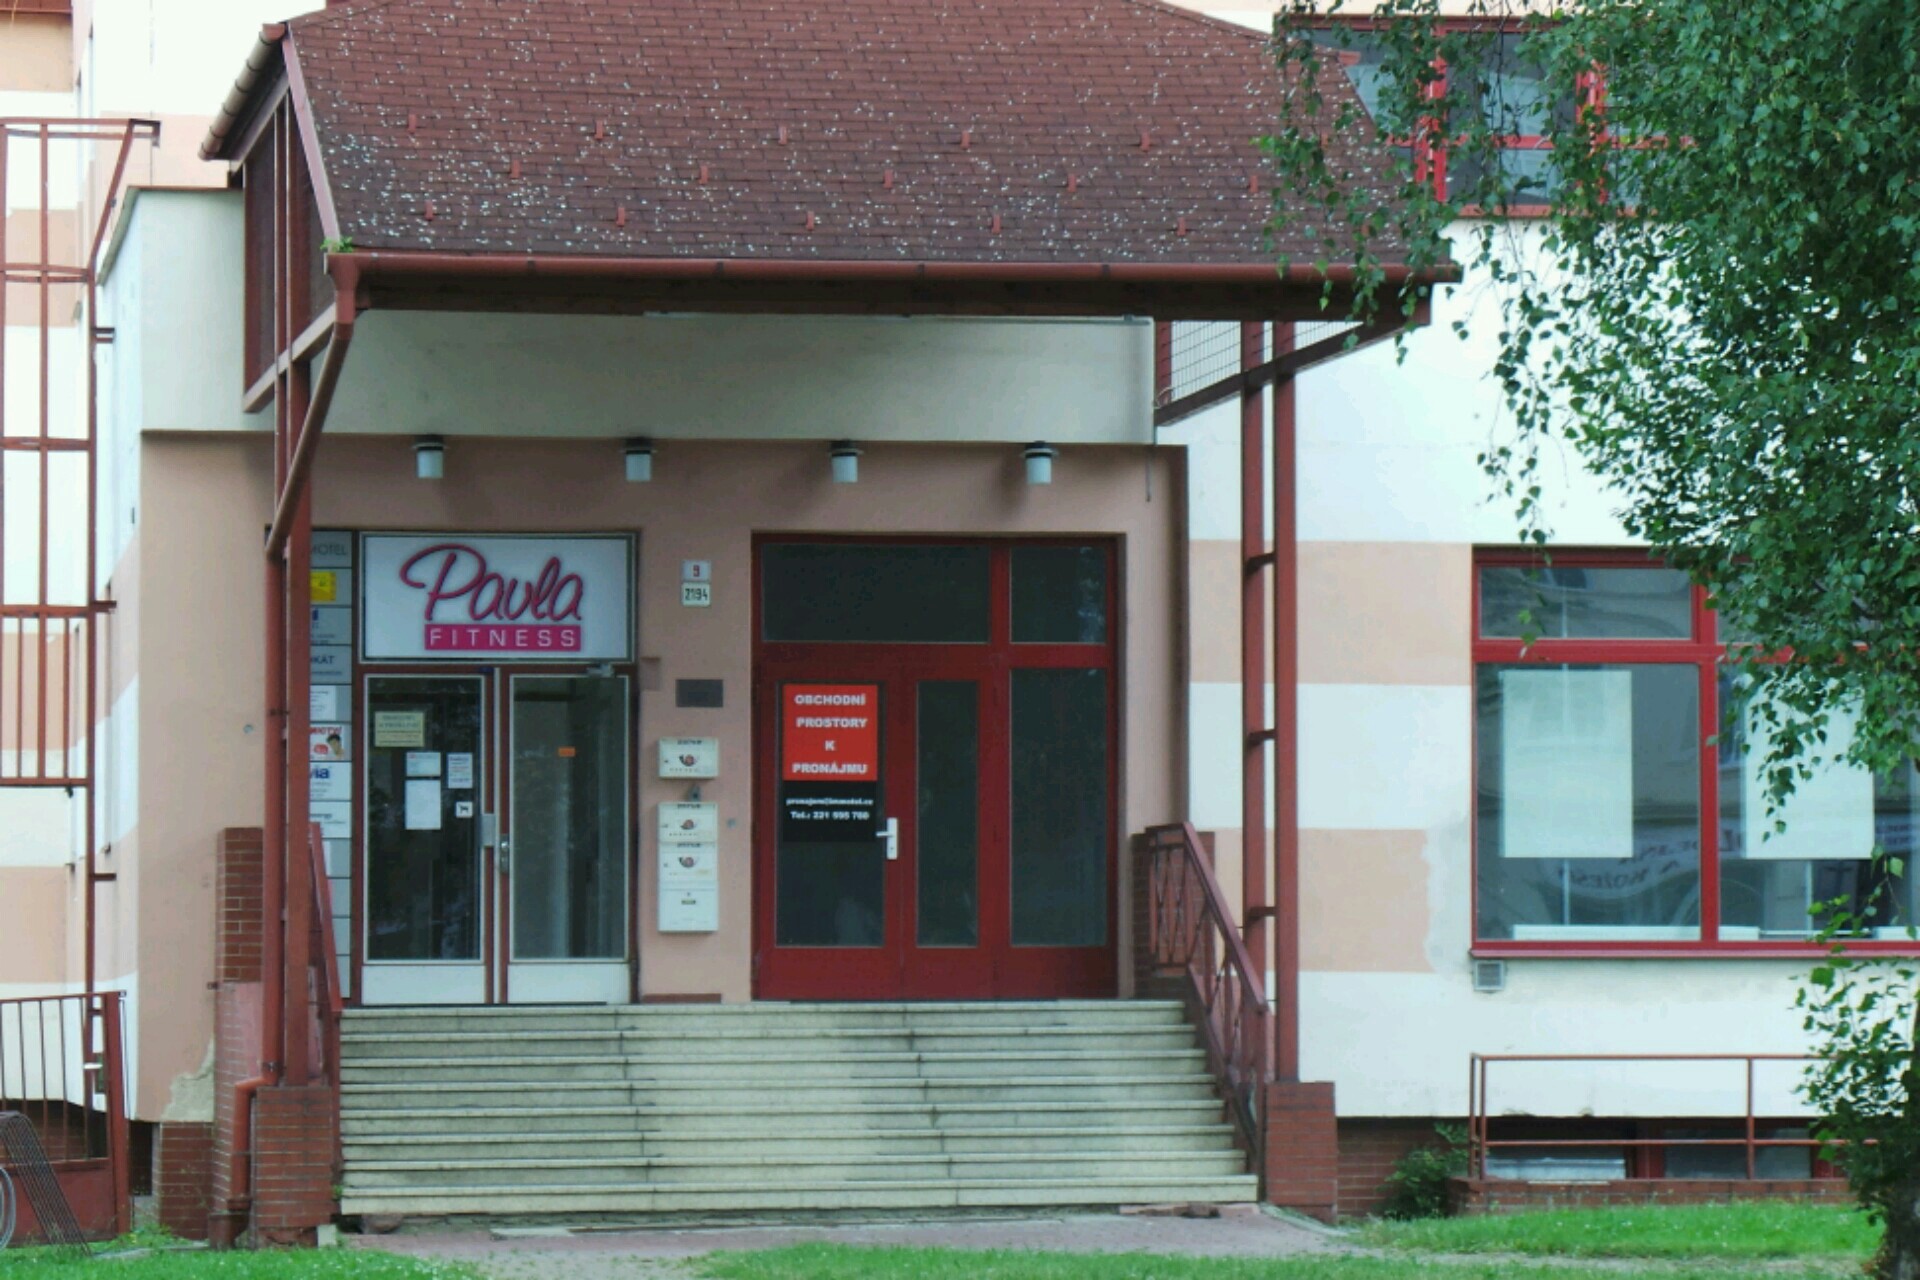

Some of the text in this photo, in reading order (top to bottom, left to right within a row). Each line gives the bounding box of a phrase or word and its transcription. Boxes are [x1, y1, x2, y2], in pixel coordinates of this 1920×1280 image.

[693, 565, 700, 577] 9
[684, 588, 708, 601] 2194
[429, 628, 575, 647] FITNESS
[794, 693, 866, 706] OBCHODNÍ
[796, 717, 868, 728] PROSTORY
[824, 740, 836, 751] K
[792, 761, 868, 774] PRONÁJMU
